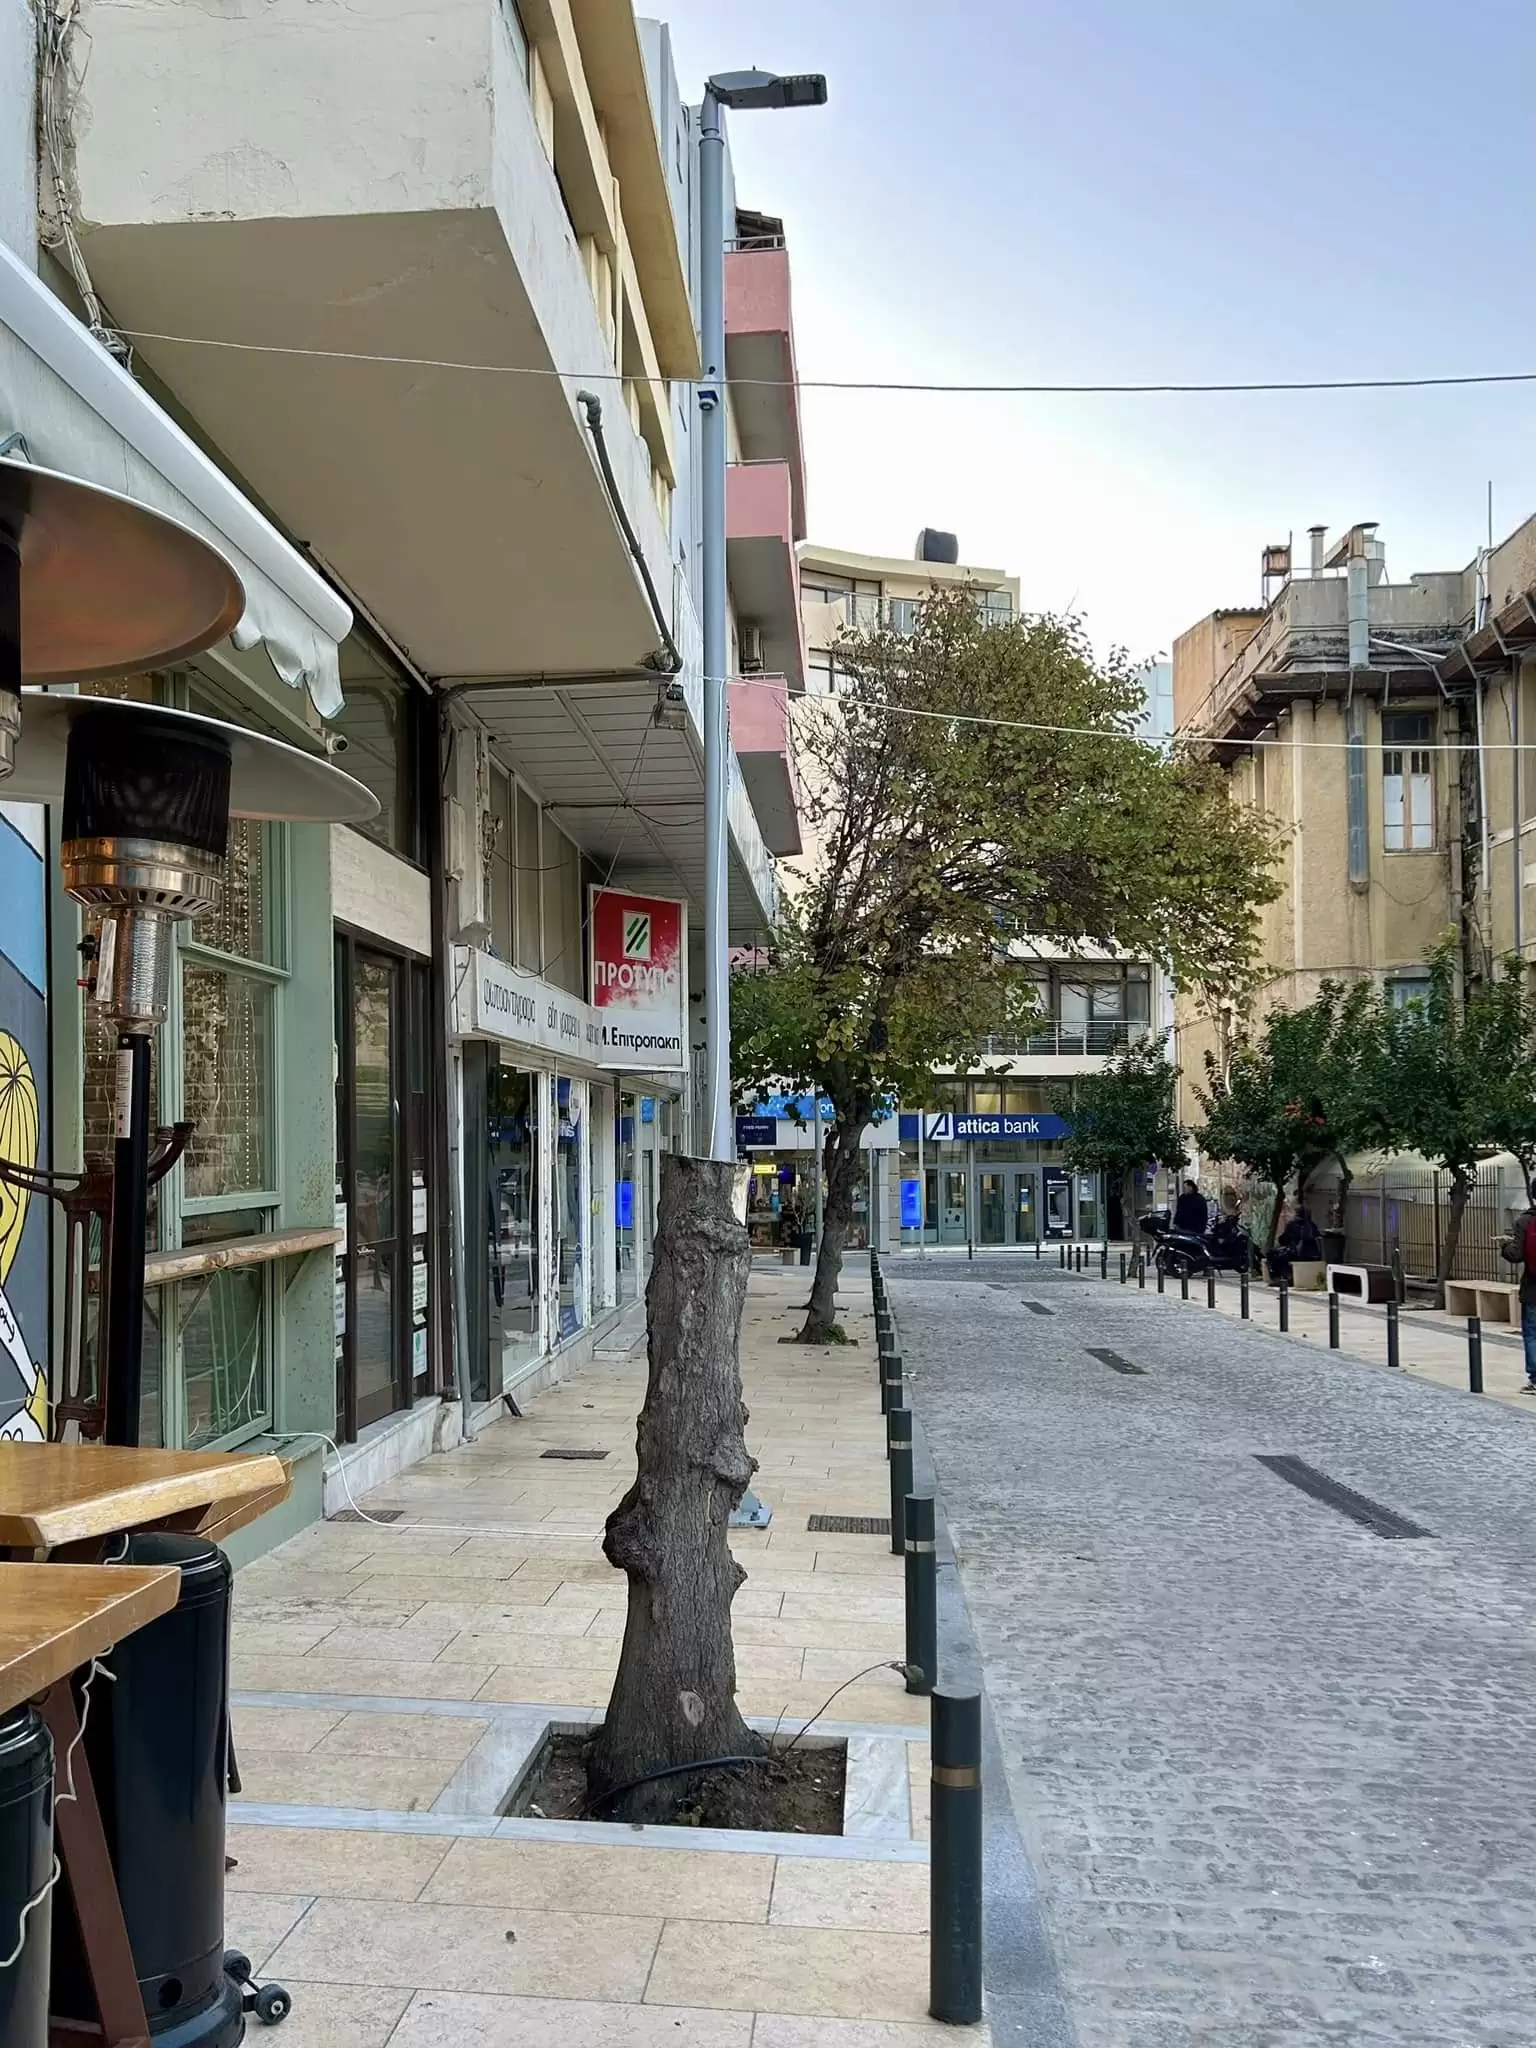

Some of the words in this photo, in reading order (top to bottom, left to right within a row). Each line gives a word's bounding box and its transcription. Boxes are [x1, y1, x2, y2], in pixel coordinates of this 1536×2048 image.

[611, 1027, 680, 1051] Επιτροπακη
[957, 1119, 1000, 1134] attica
[1004, 1118, 1040, 1134] bank
